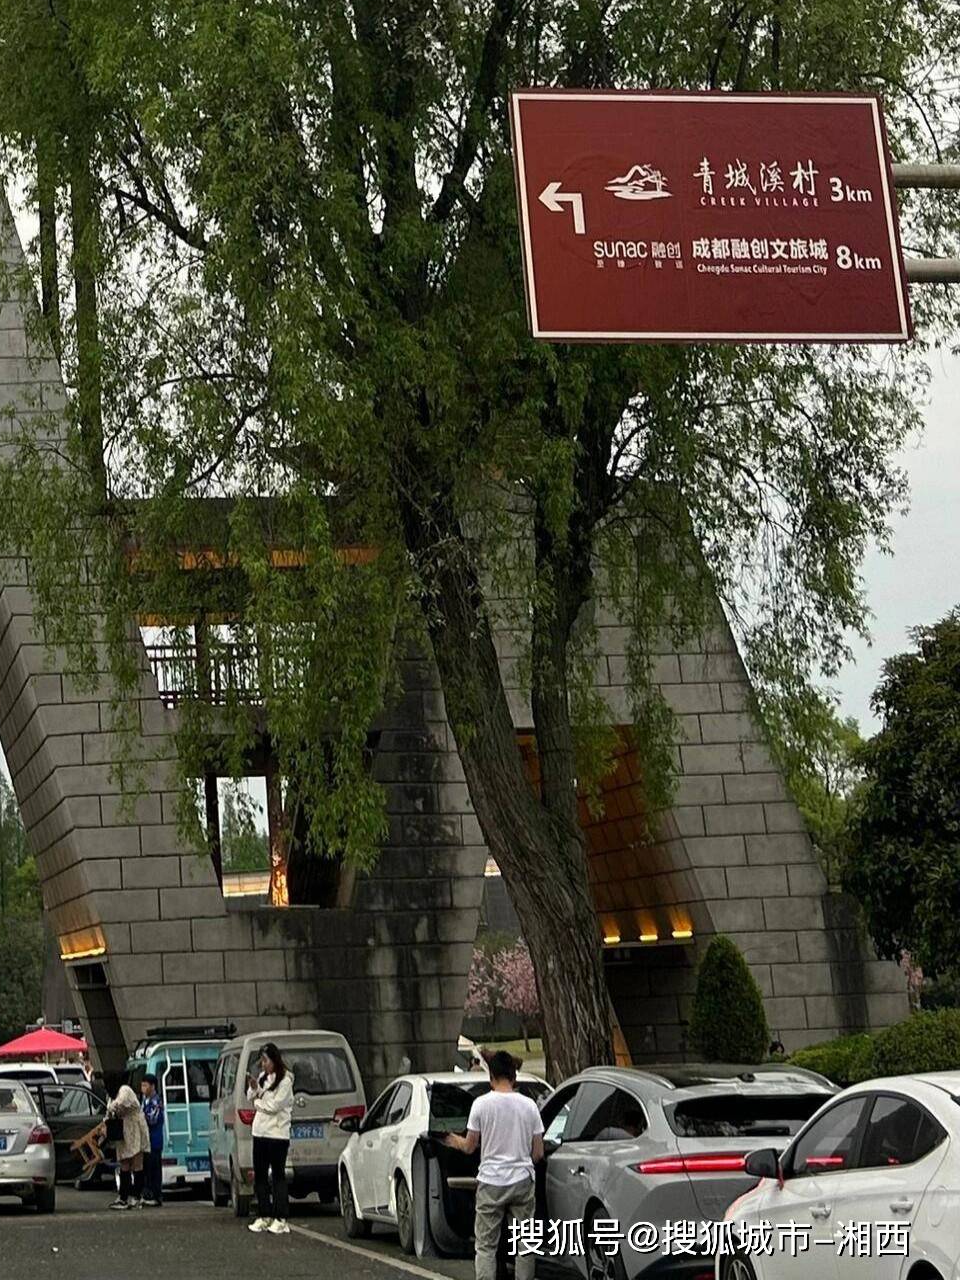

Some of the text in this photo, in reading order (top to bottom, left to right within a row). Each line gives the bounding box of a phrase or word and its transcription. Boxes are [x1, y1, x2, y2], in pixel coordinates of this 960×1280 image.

[693, 157, 873, 202] 青城溪村 3km
[700, 196, 820, 208] CREEK VILLAGE
[593, 240, 682, 259] sunac 融创
[692, 237, 882, 270] 成都融创文旅城 8km
[697, 263, 828, 275] Chengdu Sunac Cultural Tourism City
